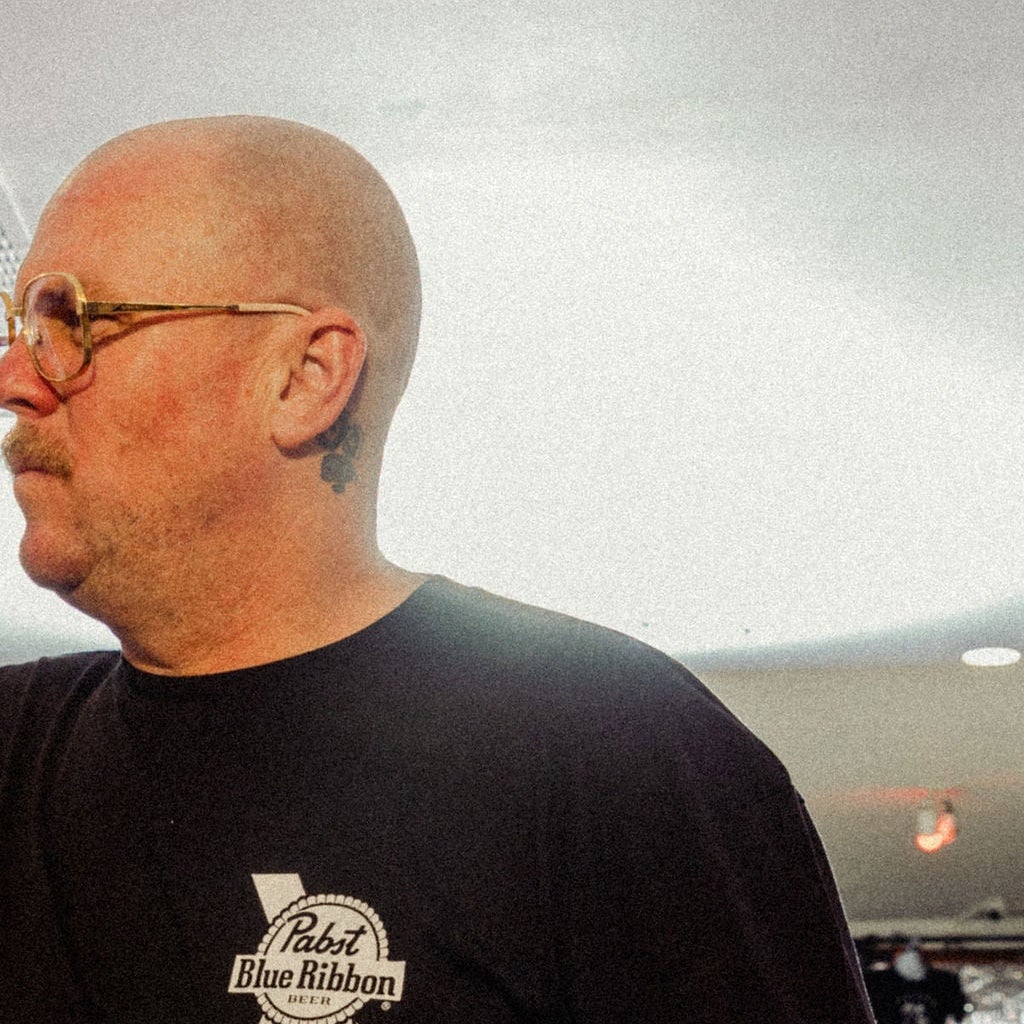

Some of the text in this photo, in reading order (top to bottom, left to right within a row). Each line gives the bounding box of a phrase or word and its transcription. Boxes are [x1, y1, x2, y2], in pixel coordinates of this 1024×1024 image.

[280, 911, 367, 956] Pabst
[234, 958, 396, 997] Blue Ribbon
[288, 994, 332, 1006] BEER
